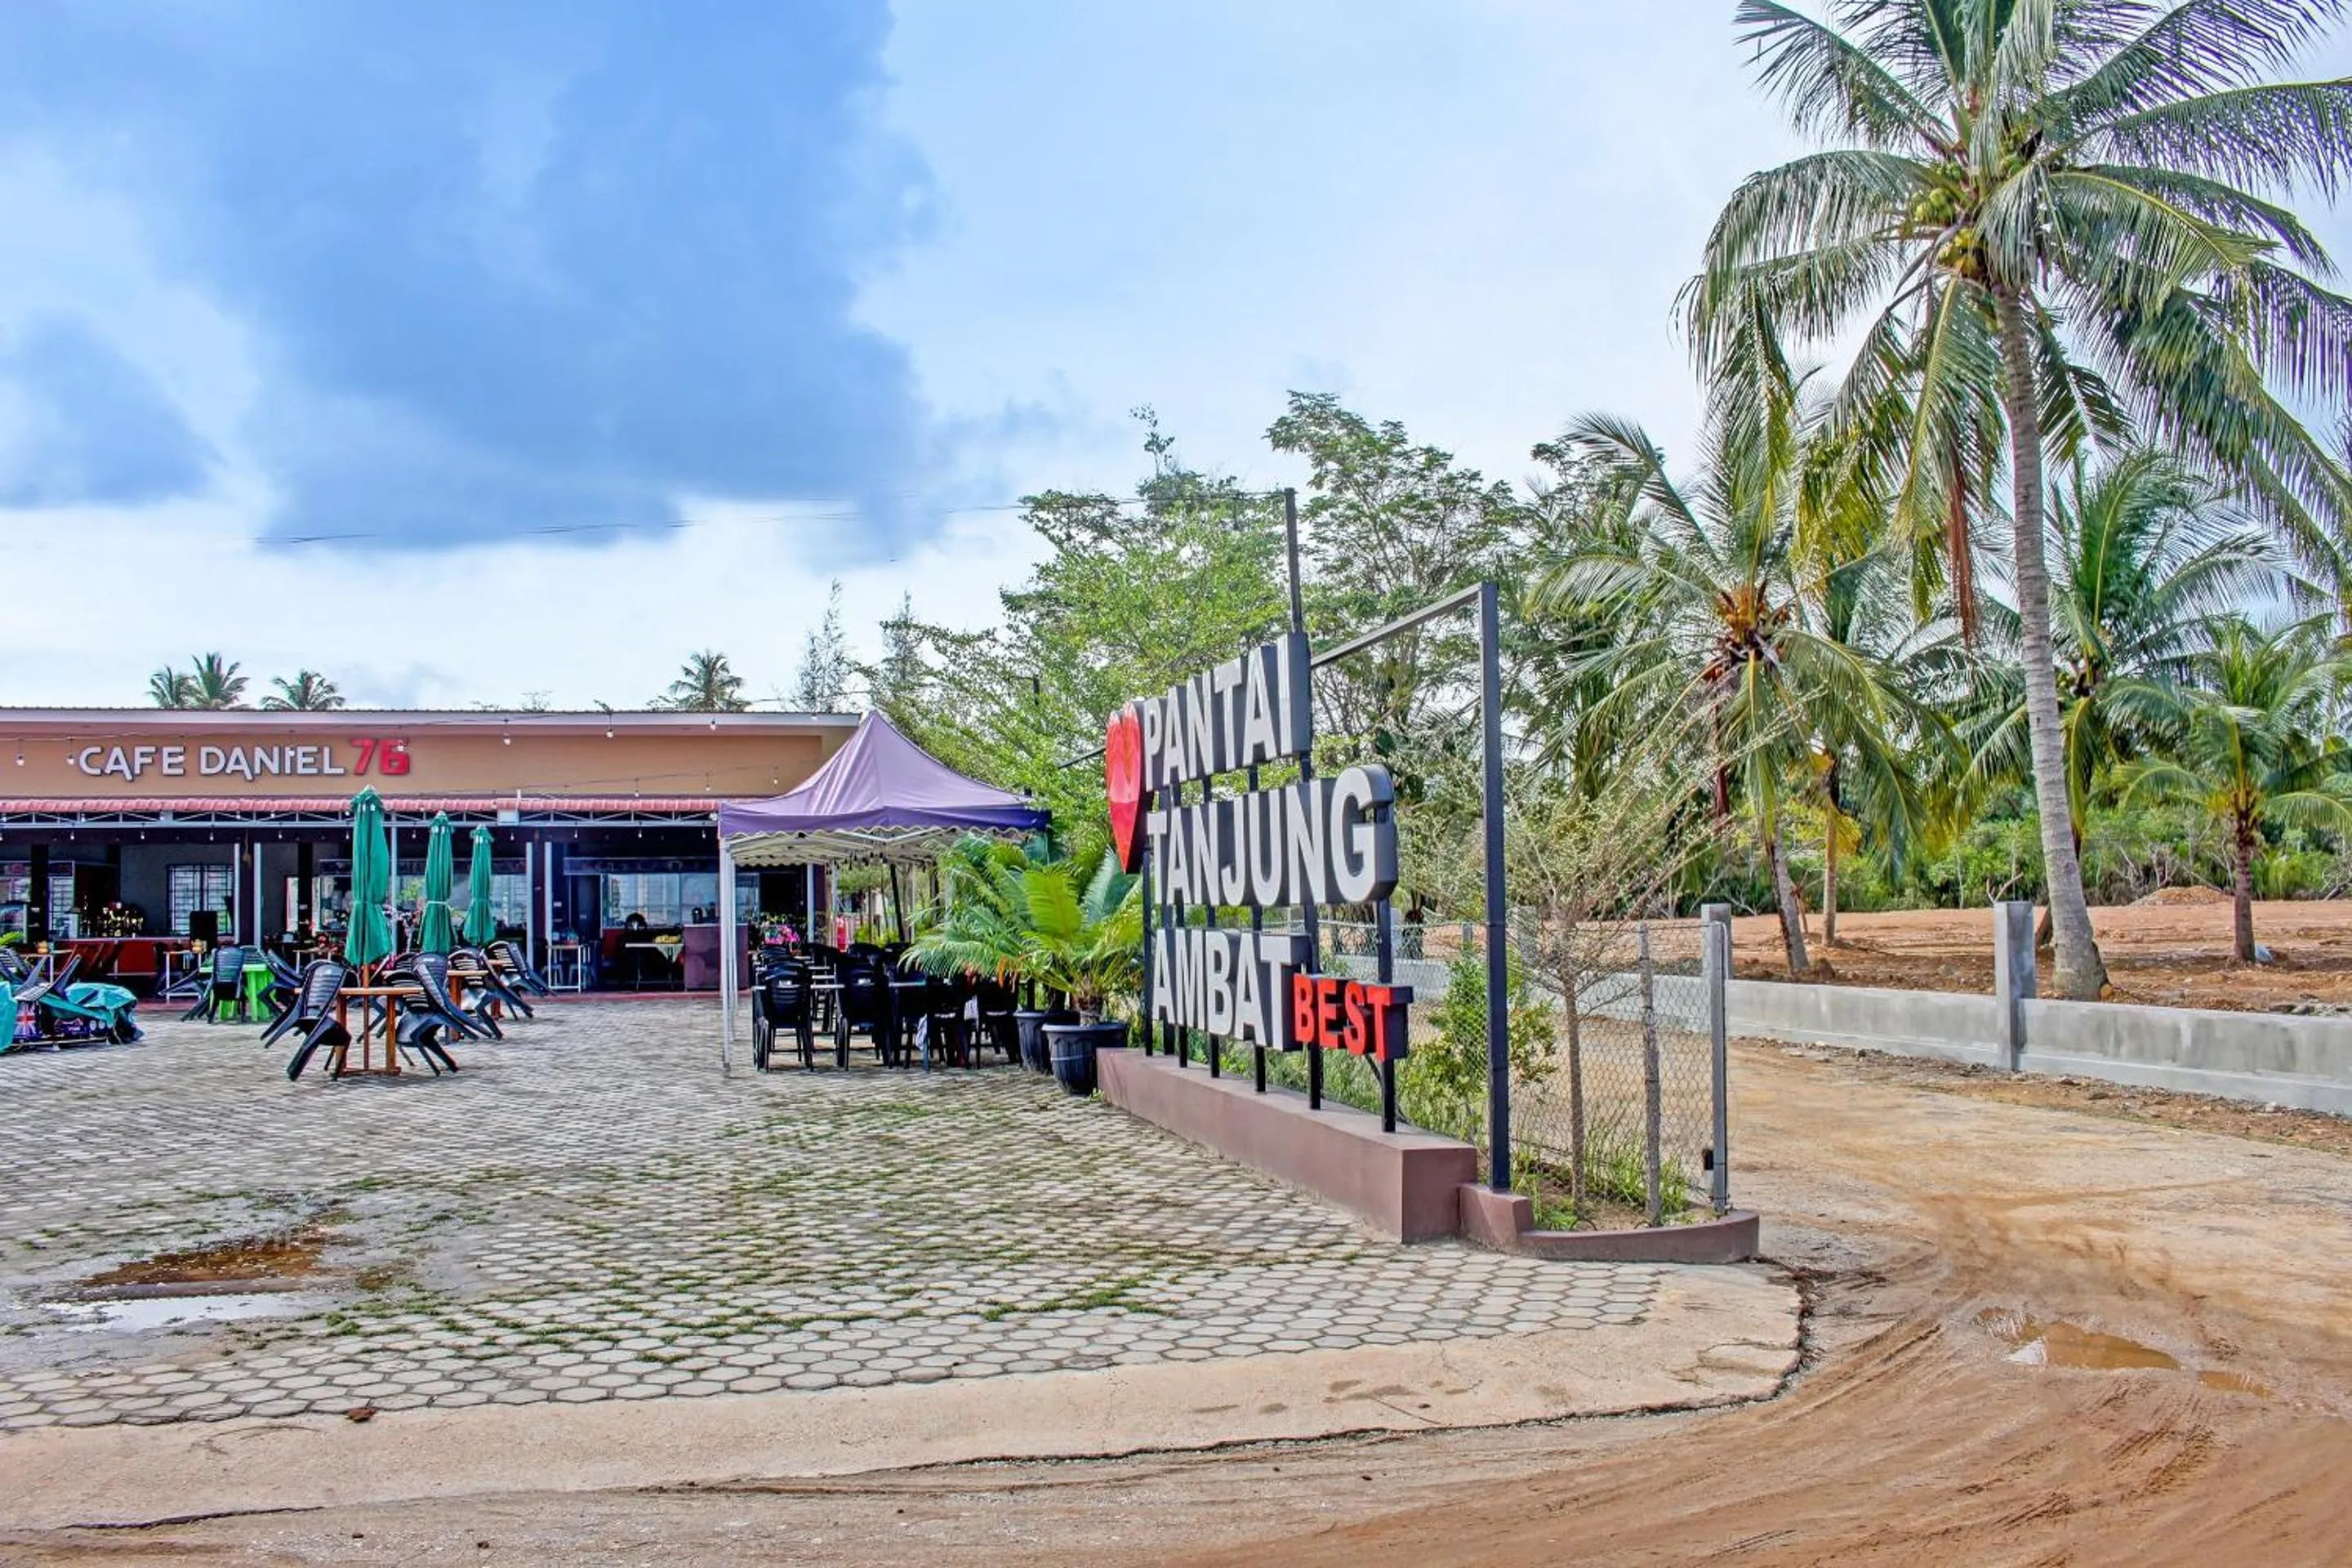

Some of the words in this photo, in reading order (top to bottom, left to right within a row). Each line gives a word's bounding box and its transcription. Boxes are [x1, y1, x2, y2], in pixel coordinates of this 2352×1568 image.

[79, 745, 185, 781] CAFE
[200, 745, 345, 781] DANIEL
[350, 737, 410, 776] 76
[1145, 634, 1295, 791] PANTAI
[1147, 767, 1380, 906] TANJUNG
[1152, 929, 1294, 1051] AMBAT
[1294, 973, 1392, 1060] BEST
